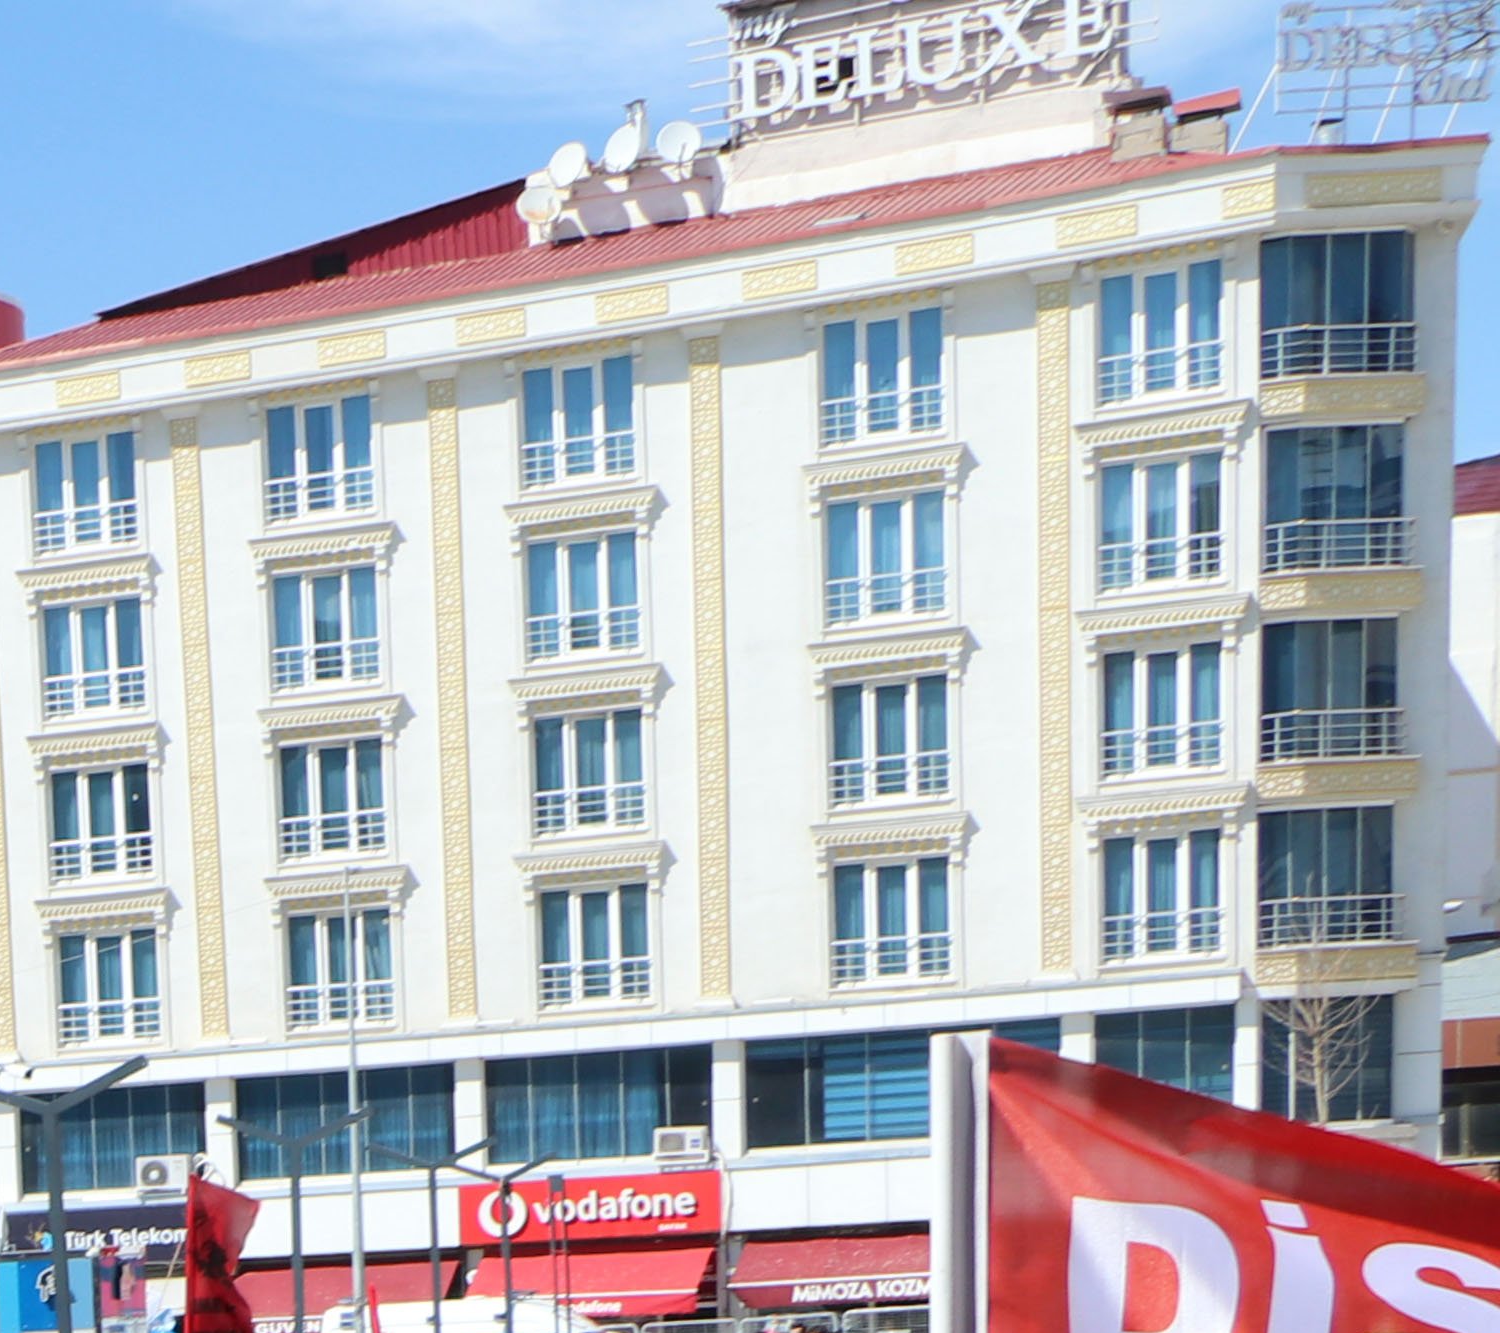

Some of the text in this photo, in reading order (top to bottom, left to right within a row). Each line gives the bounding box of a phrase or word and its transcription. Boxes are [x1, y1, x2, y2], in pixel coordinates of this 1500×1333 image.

[731, 0, 1112, 122] DELUXE
[531, 1188, 697, 1226] vodafone
[64, 1228, 108, 1250] Türk
